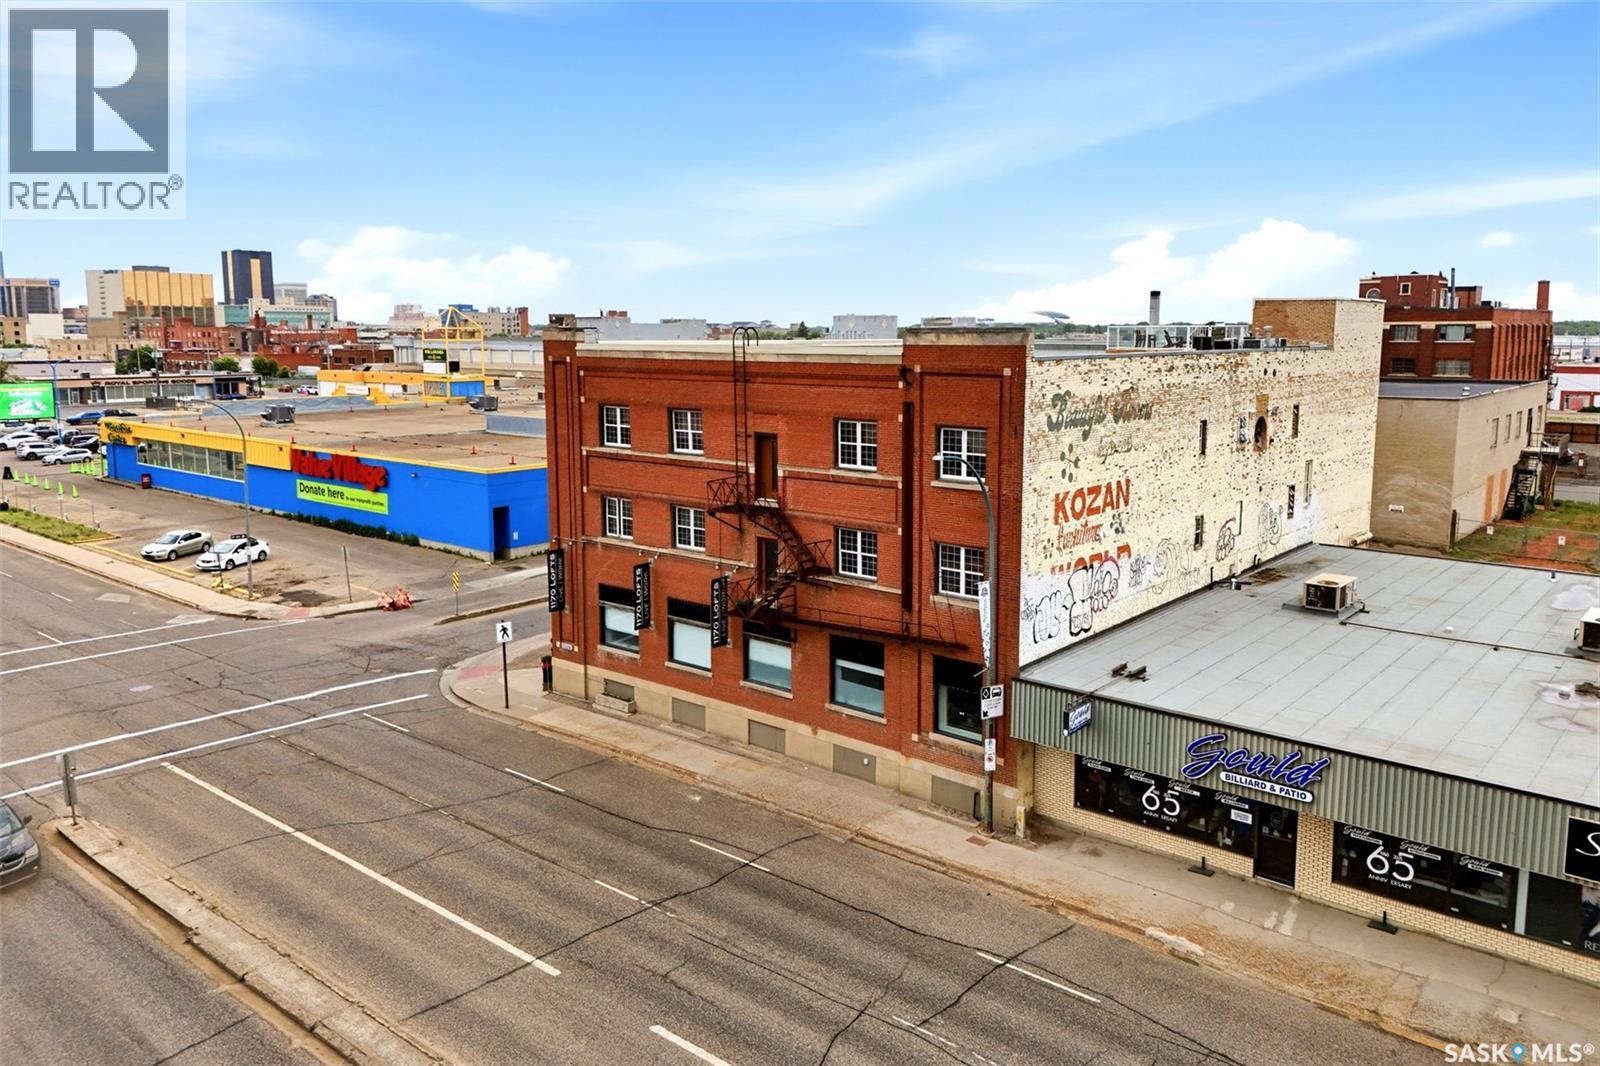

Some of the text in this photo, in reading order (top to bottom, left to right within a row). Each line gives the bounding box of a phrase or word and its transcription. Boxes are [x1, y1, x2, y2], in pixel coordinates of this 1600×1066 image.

[299, 482, 326, 497] Donate
[327, 487, 345, 500] here
[1054, 478, 1131, 525] KOZAN
[1181, 733, 1331, 787] Gould
[1142, 785, 1180, 816] 65
[1224, 773, 1307, 800] BILLIARD & PATIO
[1366, 845, 1415, 881] 65
[1368, 874, 1412, 890] ANNIV ERSARY
